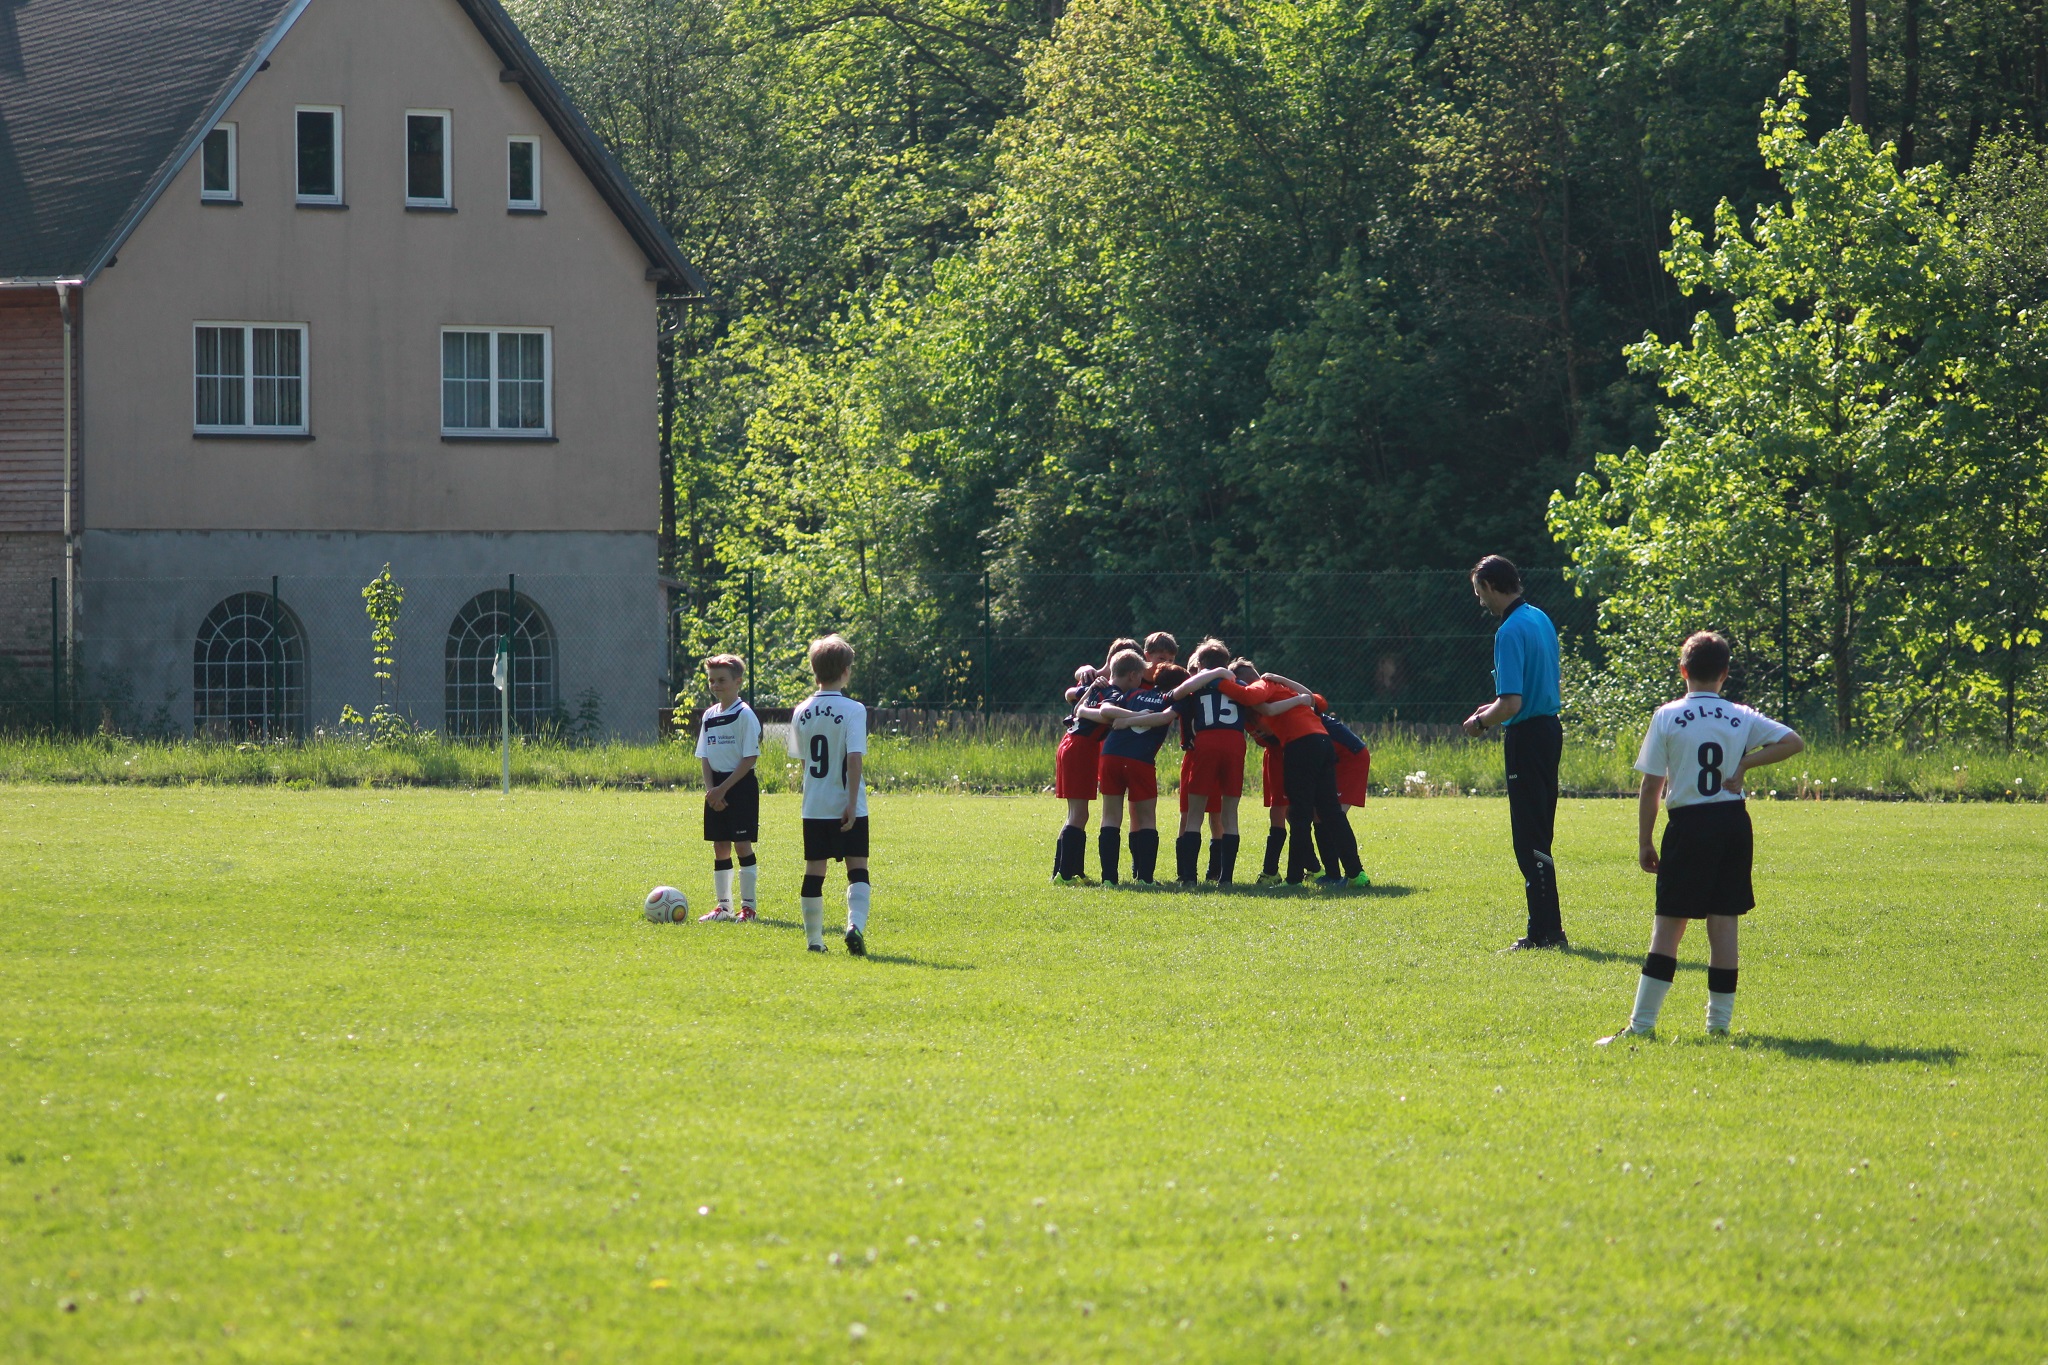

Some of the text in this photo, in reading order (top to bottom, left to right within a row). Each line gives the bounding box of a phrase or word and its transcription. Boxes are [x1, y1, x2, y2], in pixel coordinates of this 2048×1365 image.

[800, 705, 844, 725] SG L-S-G
[1200, 694, 1239, 726] 15
[1674, 706, 1741, 728] SG L-S-G
[810, 734, 829, 778] 9
[1697, 742, 1724, 796] 8
